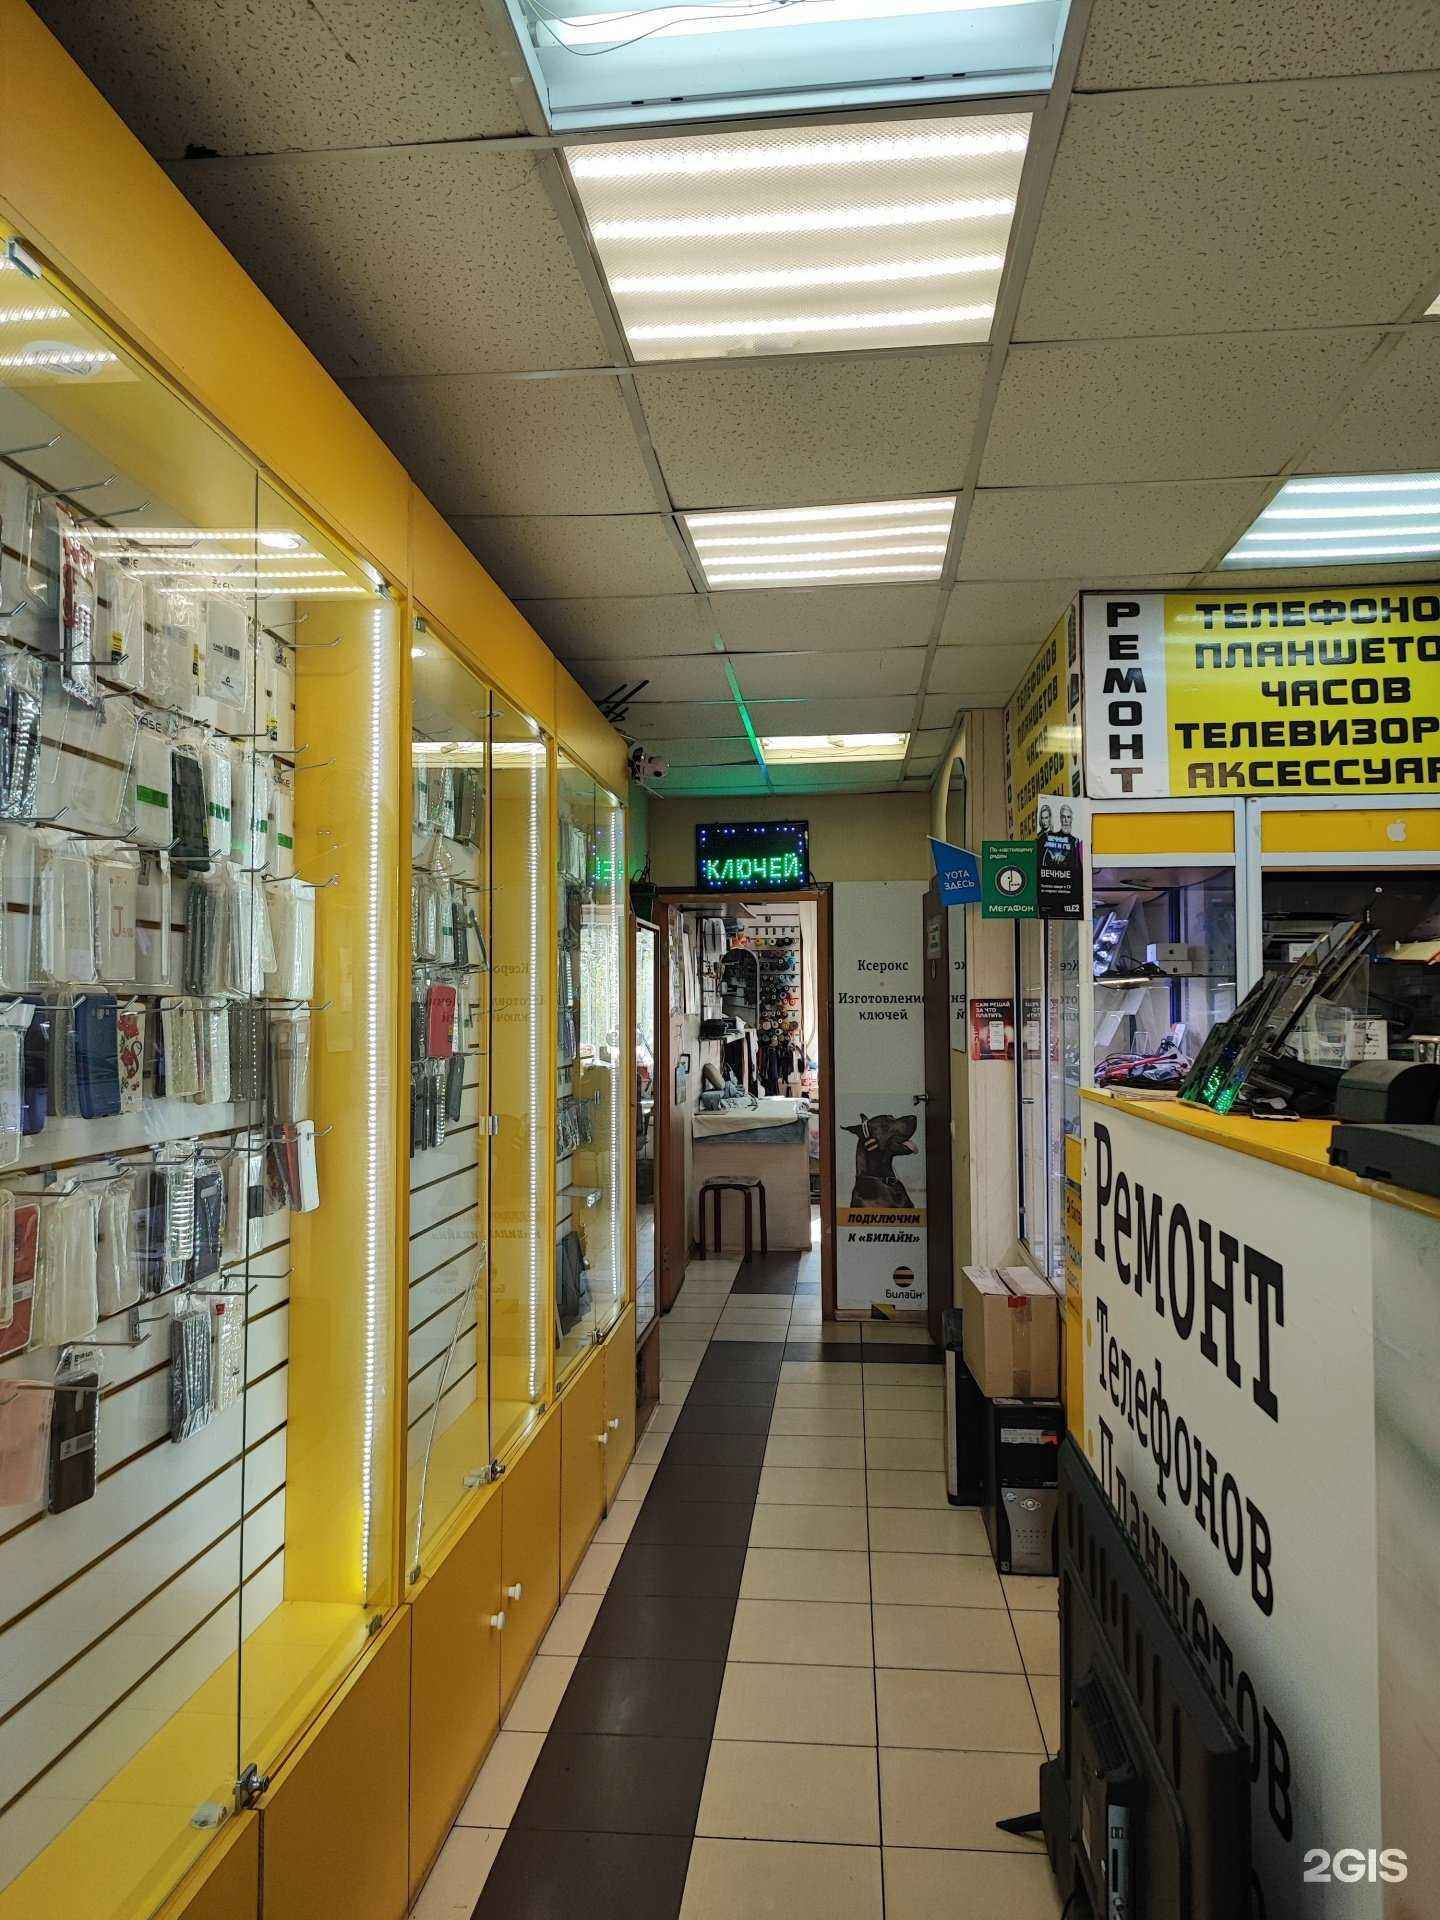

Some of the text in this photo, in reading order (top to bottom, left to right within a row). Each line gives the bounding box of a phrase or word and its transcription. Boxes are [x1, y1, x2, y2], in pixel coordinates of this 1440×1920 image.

[1195, 595, 1440, 630] ТЕЛЕФОНО
[1195, 635, 1440, 669] ПЛАНШЕТО
[1102, 602, 1147, 793] РЕМОНТ
[1261, 676, 1411, 707] ЧАСОВ
[1174, 716, 1440, 749] ТЕЛЕВИЗОР
[705, 852, 800, 879] КЛЮЧЕЙ
[944, 870, 970, 880] YOTA
[1040, 869, 1072, 879] ВЕЧНЫЕ
[944, 880, 975, 891] ЗДЕСЬ
[857, 959, 909, 973] Ксерокс
[859, 1009, 908, 1021] ключей
[858, 1231, 921, 1243] «БИЛАЙН»
[1094, 1122, 1284, 1423] Ремонт
[1096, 1297, 1274, 1617] Телефонов
